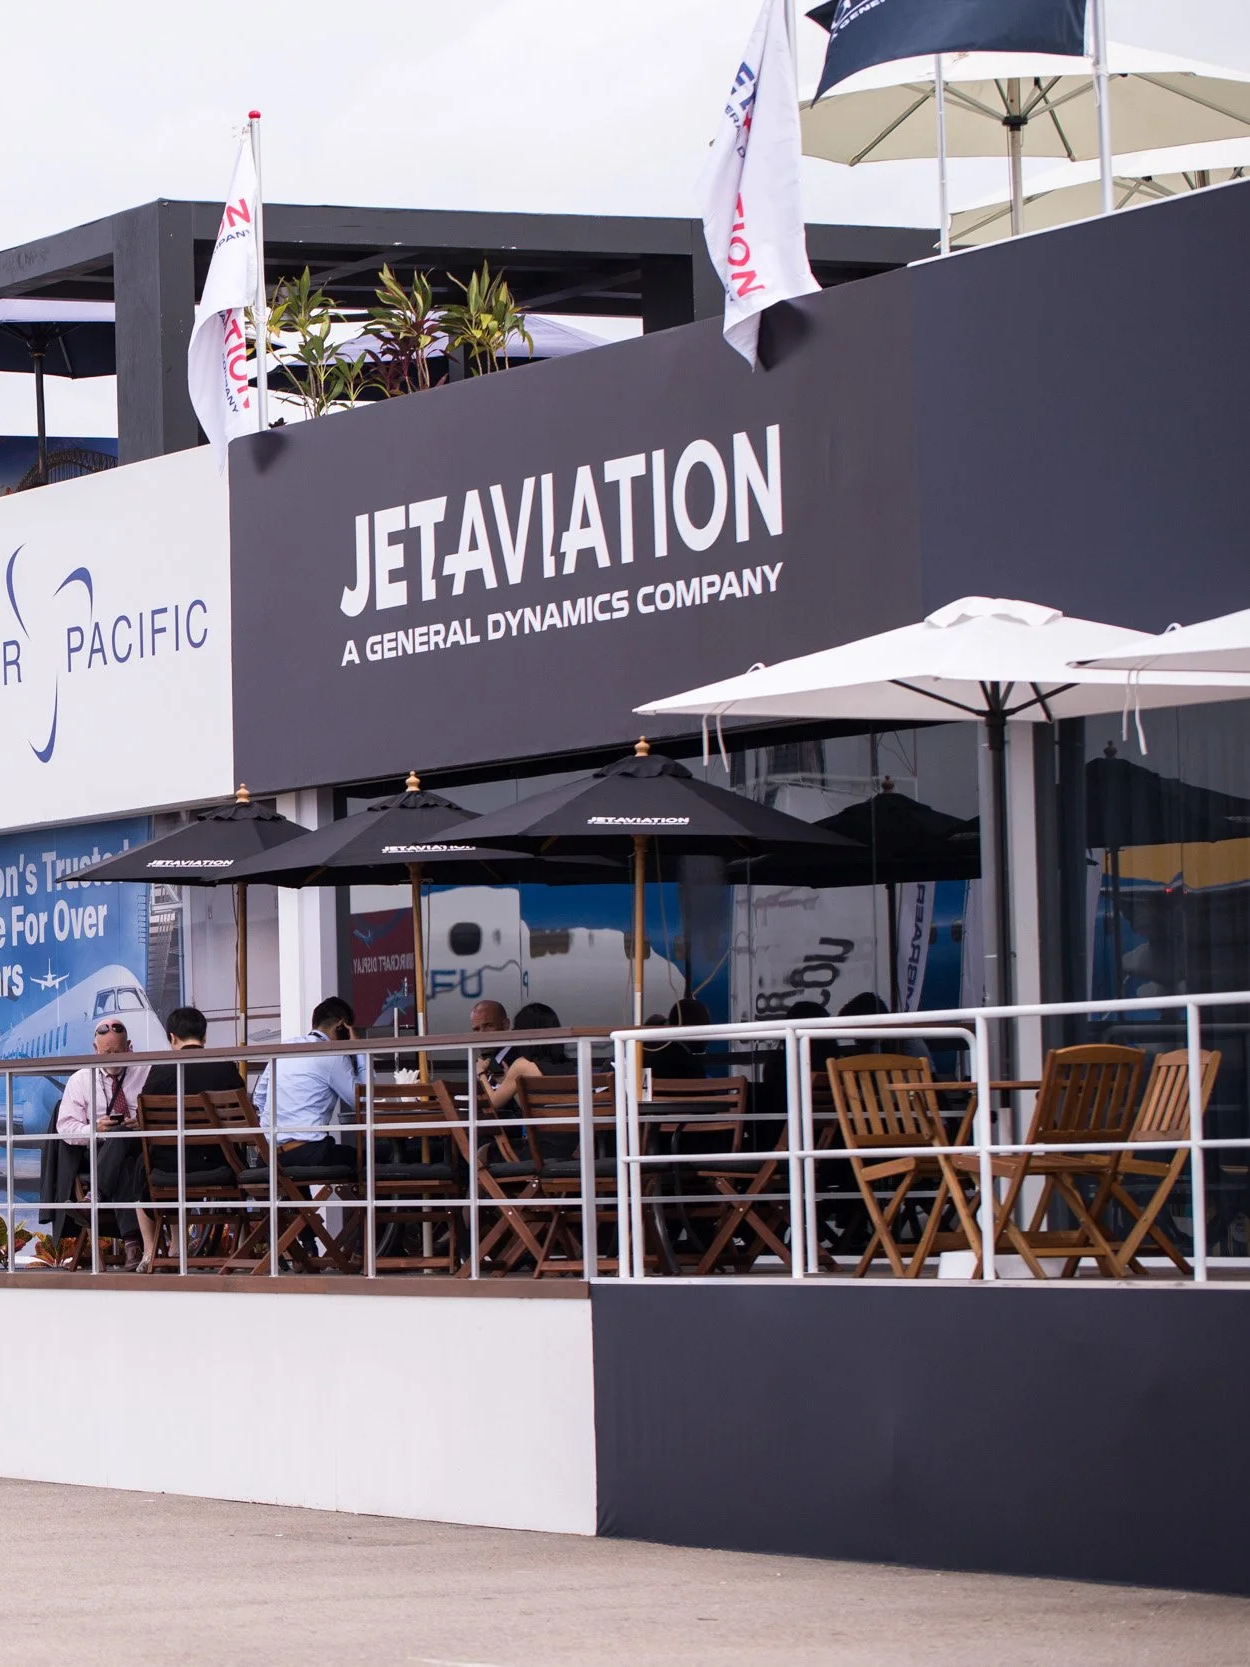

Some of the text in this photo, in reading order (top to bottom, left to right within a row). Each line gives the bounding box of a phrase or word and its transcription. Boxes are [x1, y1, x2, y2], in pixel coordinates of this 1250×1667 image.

[66, 599, 208, 673] PACIFIC
[340, 562, 784, 667] A GENERAL DYNAMICS COMPANY
[11, 905, 48, 947] For
[53, 899, 108, 942] Over
